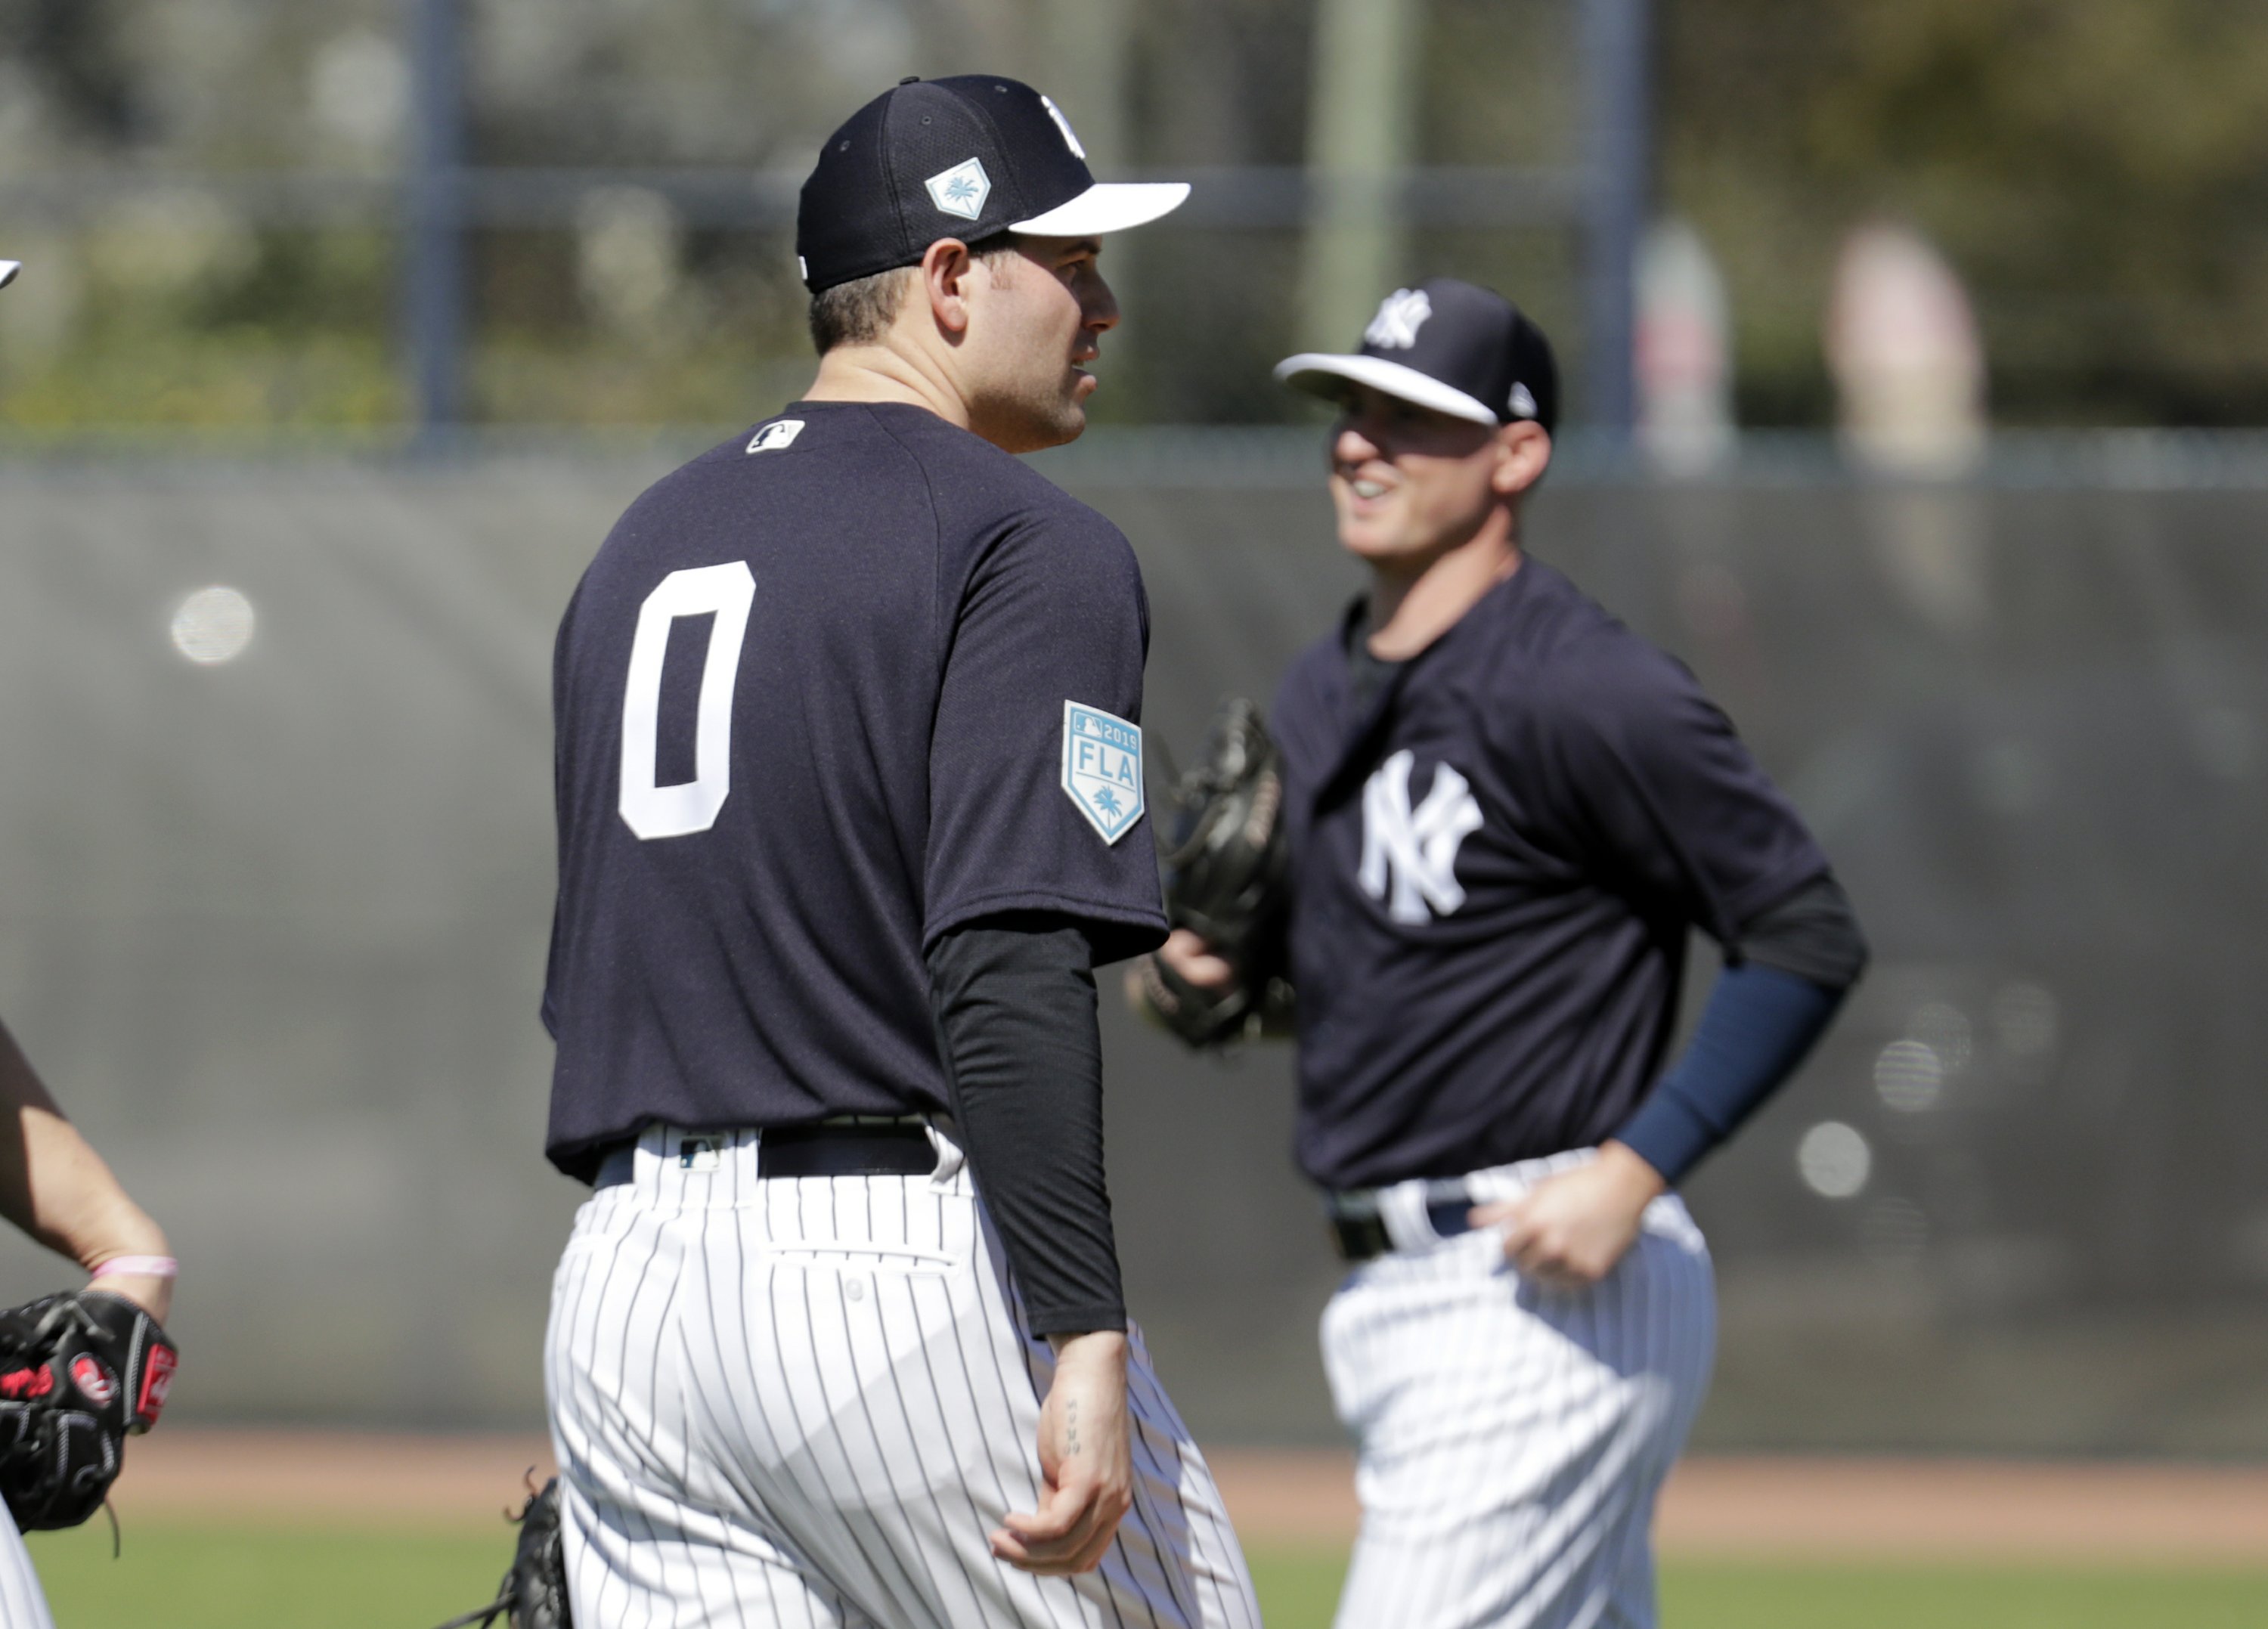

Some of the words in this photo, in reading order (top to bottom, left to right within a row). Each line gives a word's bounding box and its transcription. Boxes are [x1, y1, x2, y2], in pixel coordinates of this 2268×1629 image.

[618, 560, 756, 841] 0
[1105, 723, 1137, 750] 2019
[1080, 740, 1134, 787] FLA
[1358, 748, 1485, 927] NY
